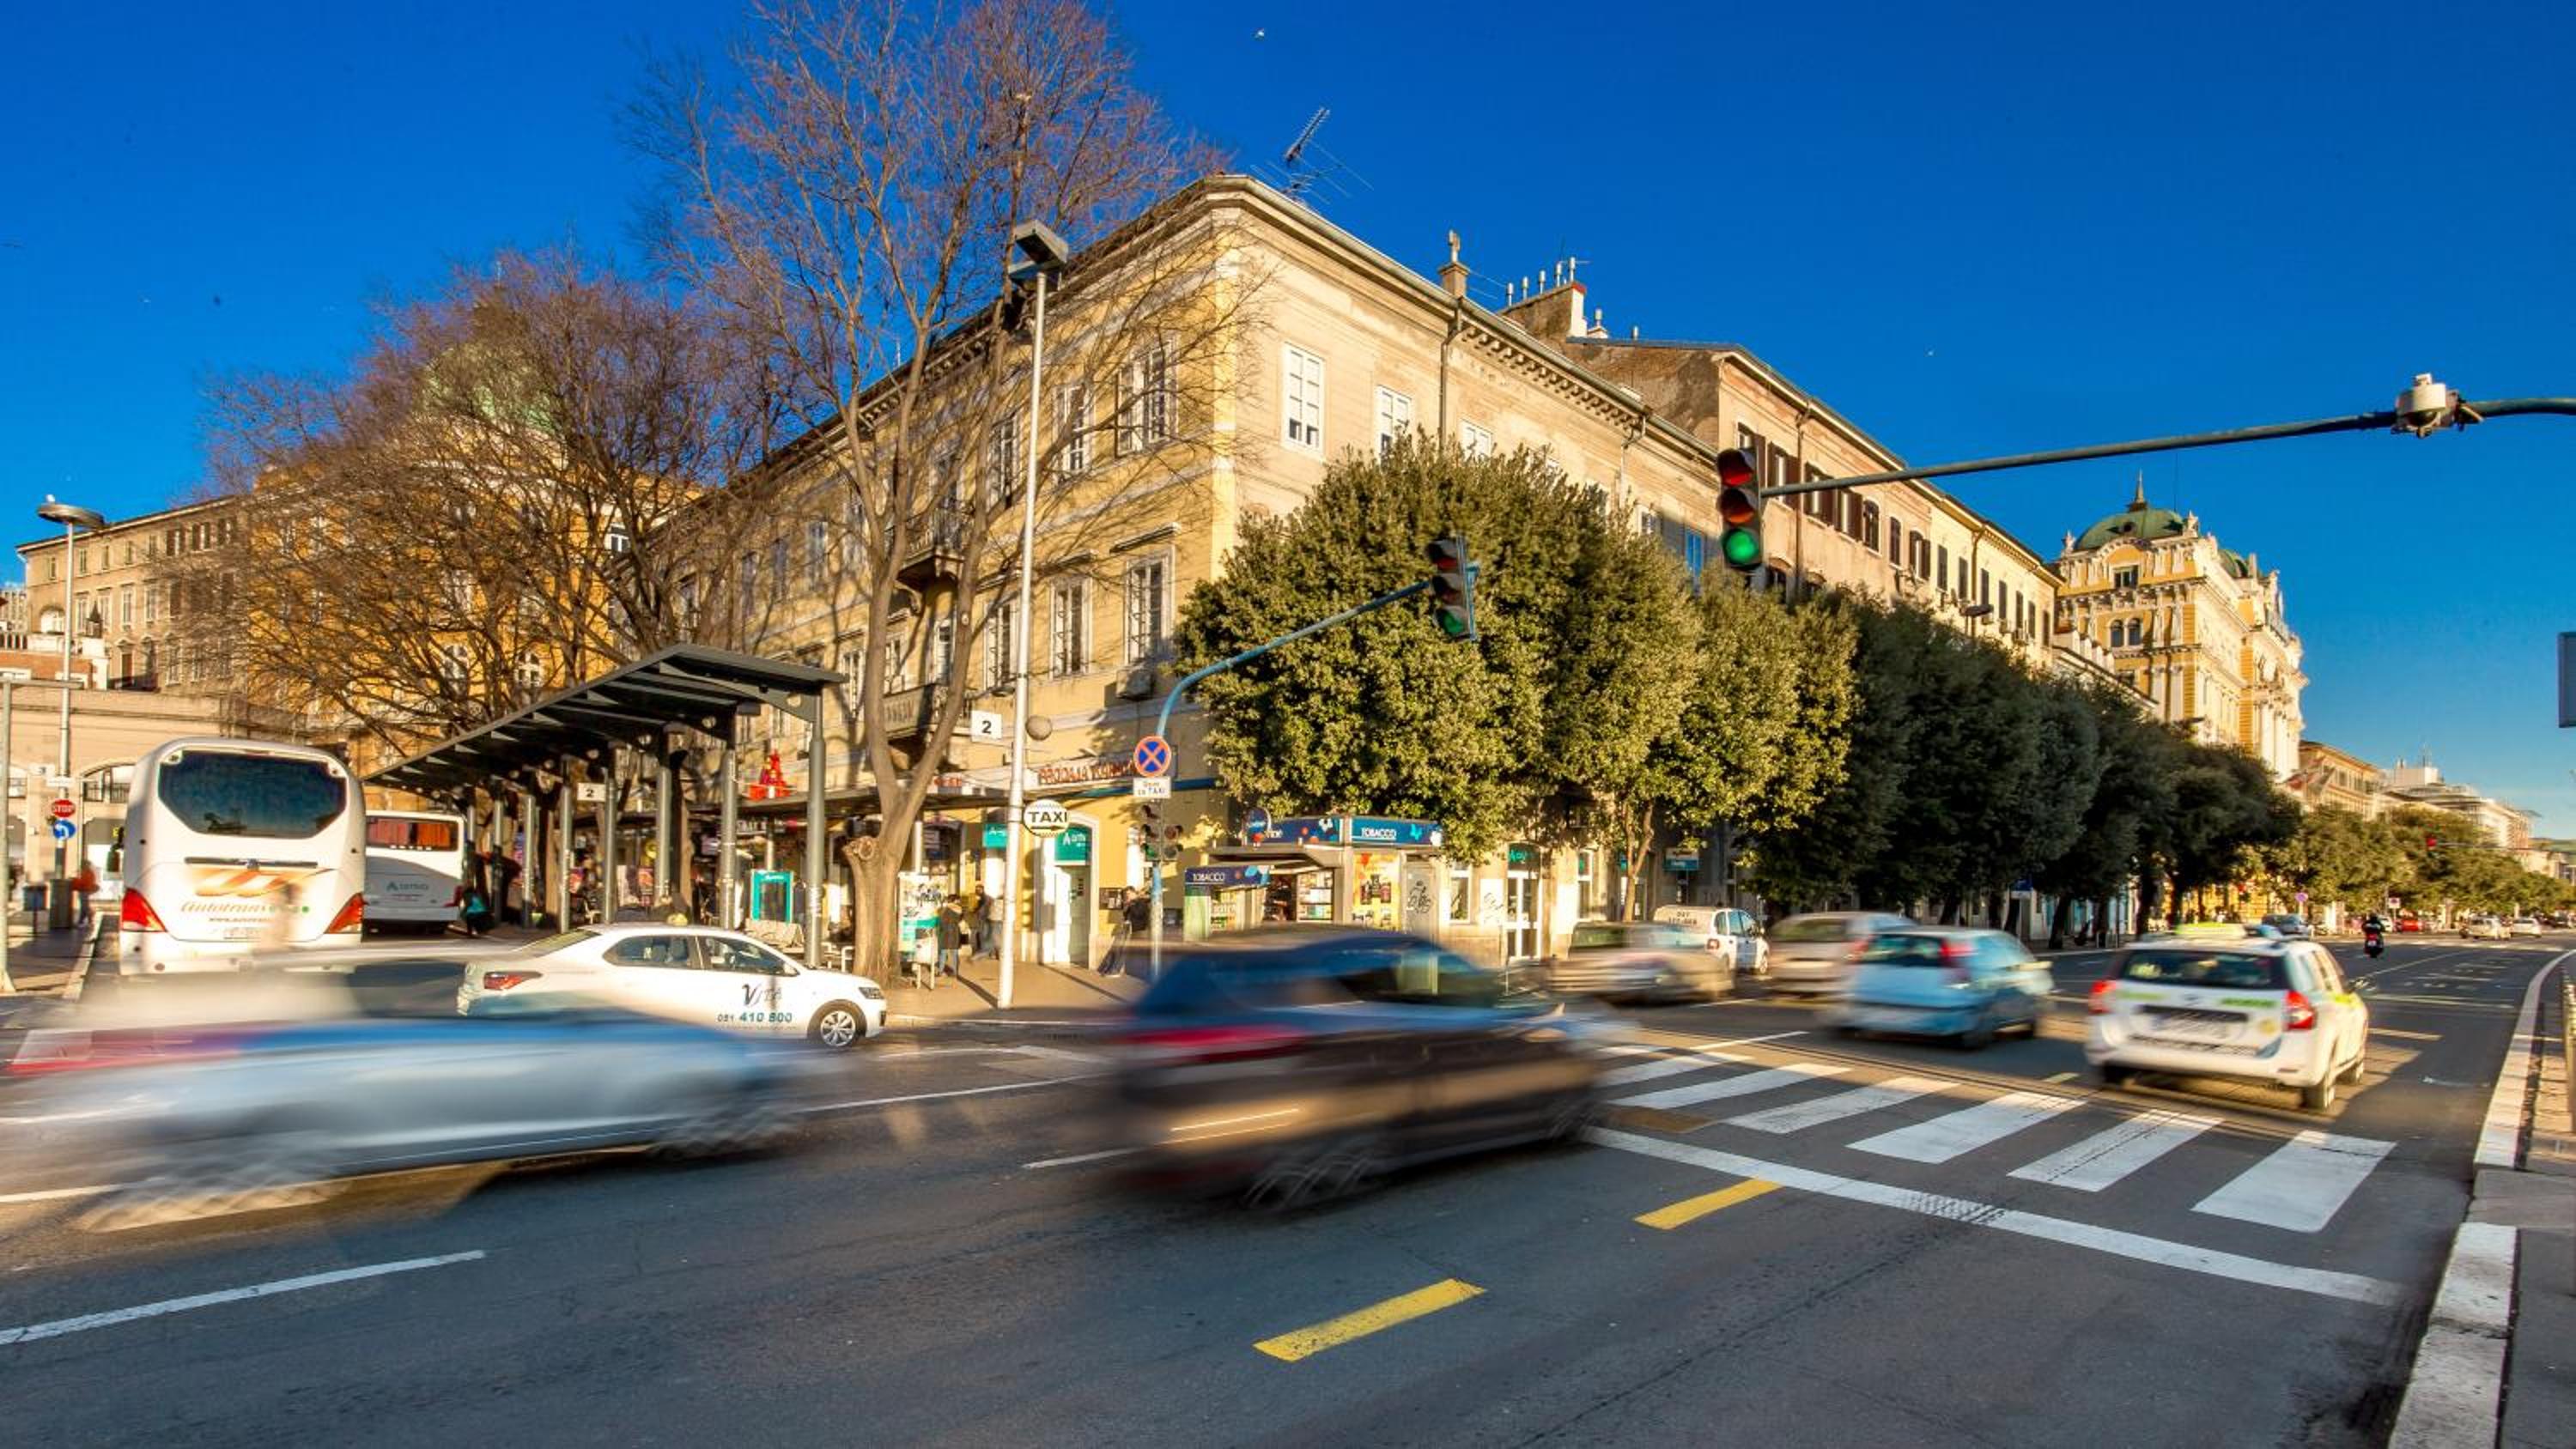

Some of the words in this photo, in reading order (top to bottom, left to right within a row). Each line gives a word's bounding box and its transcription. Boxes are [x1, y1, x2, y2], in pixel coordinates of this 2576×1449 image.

[981, 720, 992, 734] 2
[586, 789, 594, 797] 2
[52, 804, 74, 813] STOP
[1028, 811, 1067, 822] TAXI
[1361, 827, 1397, 838] TOBACCO
[1193, 872, 1225, 882] TOBACCO
[739, 1012, 765, 1022] 410
